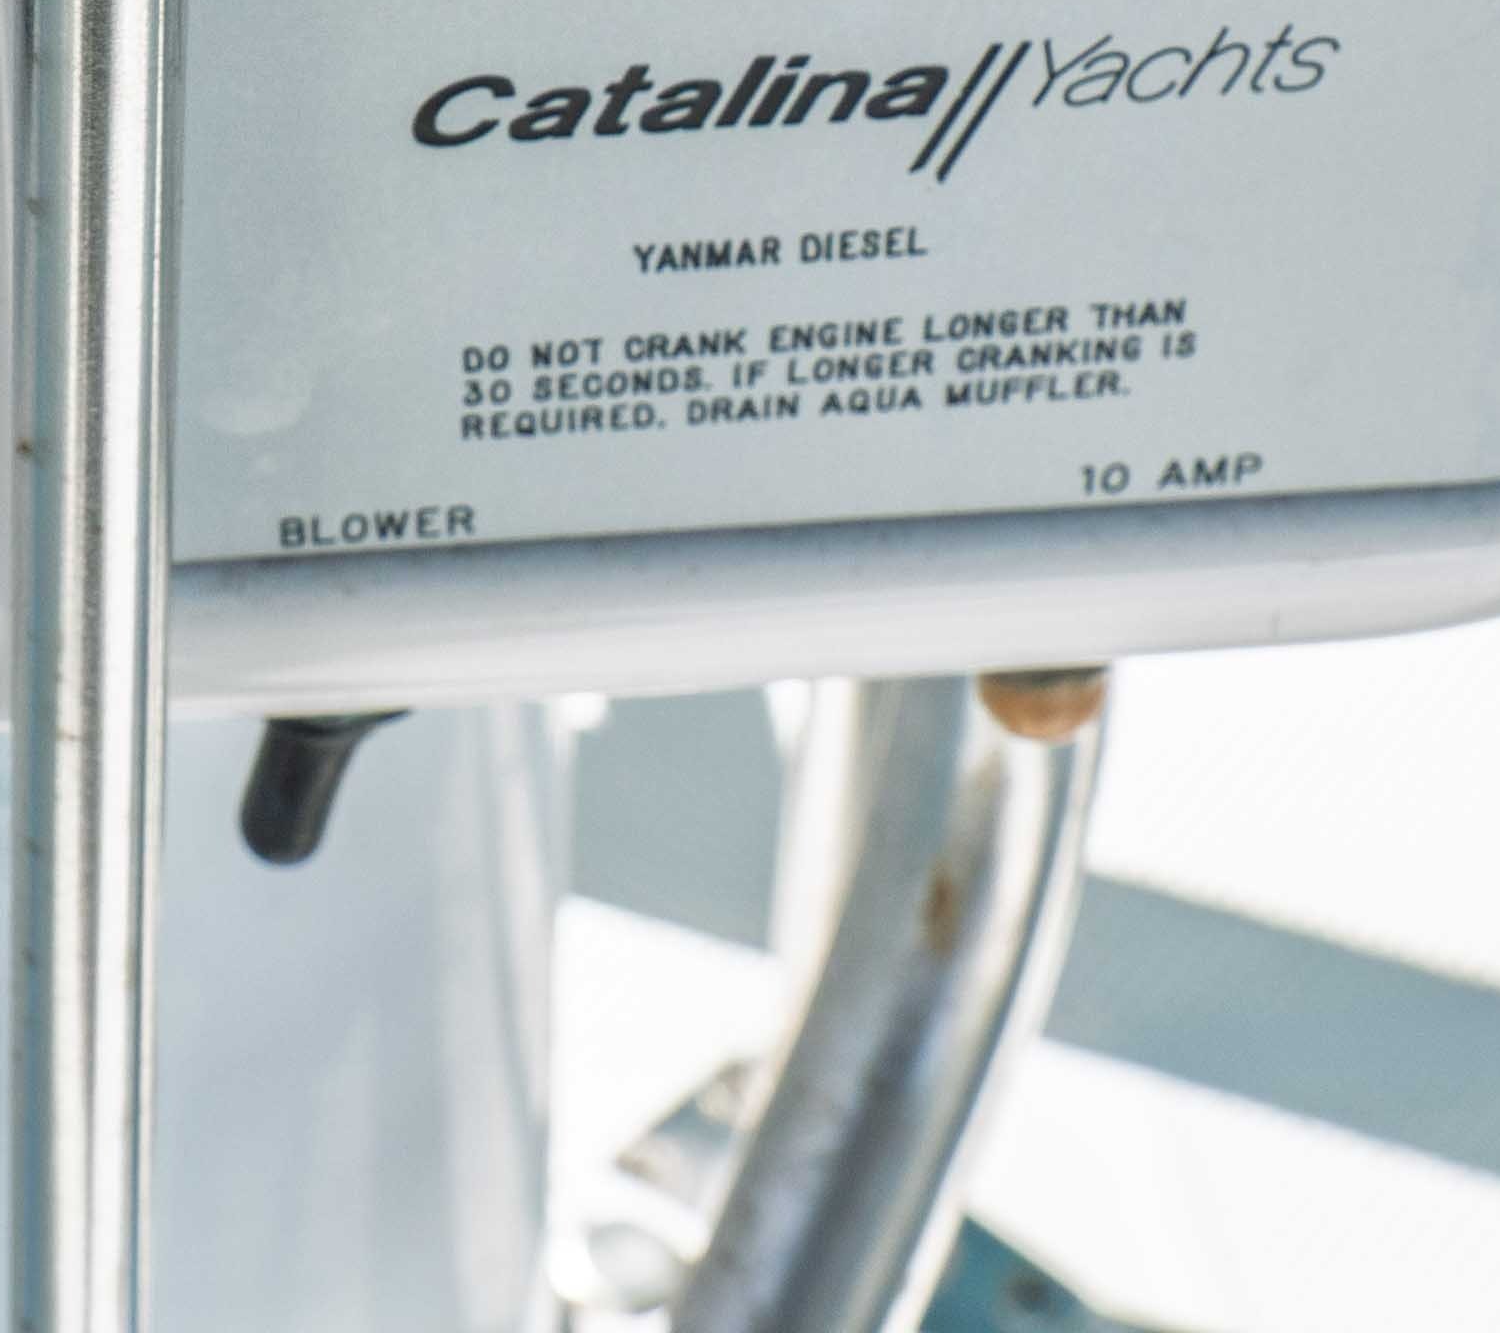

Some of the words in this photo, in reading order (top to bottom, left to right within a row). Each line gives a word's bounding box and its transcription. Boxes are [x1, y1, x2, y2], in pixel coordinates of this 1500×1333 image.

[411, 54, 950, 148] Catalina
[1031, 23, 1341, 109] Yachts
[632, 234, 782, 274] YANMAR
[799, 225, 929, 264] DIESEL
[461, 344, 511, 374] DO
[530, 337, 604, 369] NOT
[623, 328, 748, 363] CRANK
[769, 316, 905, 353] ENGINE
[924, 305, 1071, 344] LONGER
[1090, 297, 1188, 329] THAN
[461, 378, 513, 407] 30
[732, 359, 768, 389] IF
[787, 348, 936, 386] LONGER
[956, 334, 1143, 374] CRANKING
[1161, 330, 1198, 361] IS
[686, 391, 801, 427] DRAIN
[819, 385, 924, 418] AQUA
[944, 368, 1131, 409] MUFFLER.
[1080, 461, 1129, 498] 10
[1158, 451, 1264, 492] AMP
[278, 503, 477, 551] BLOWER
